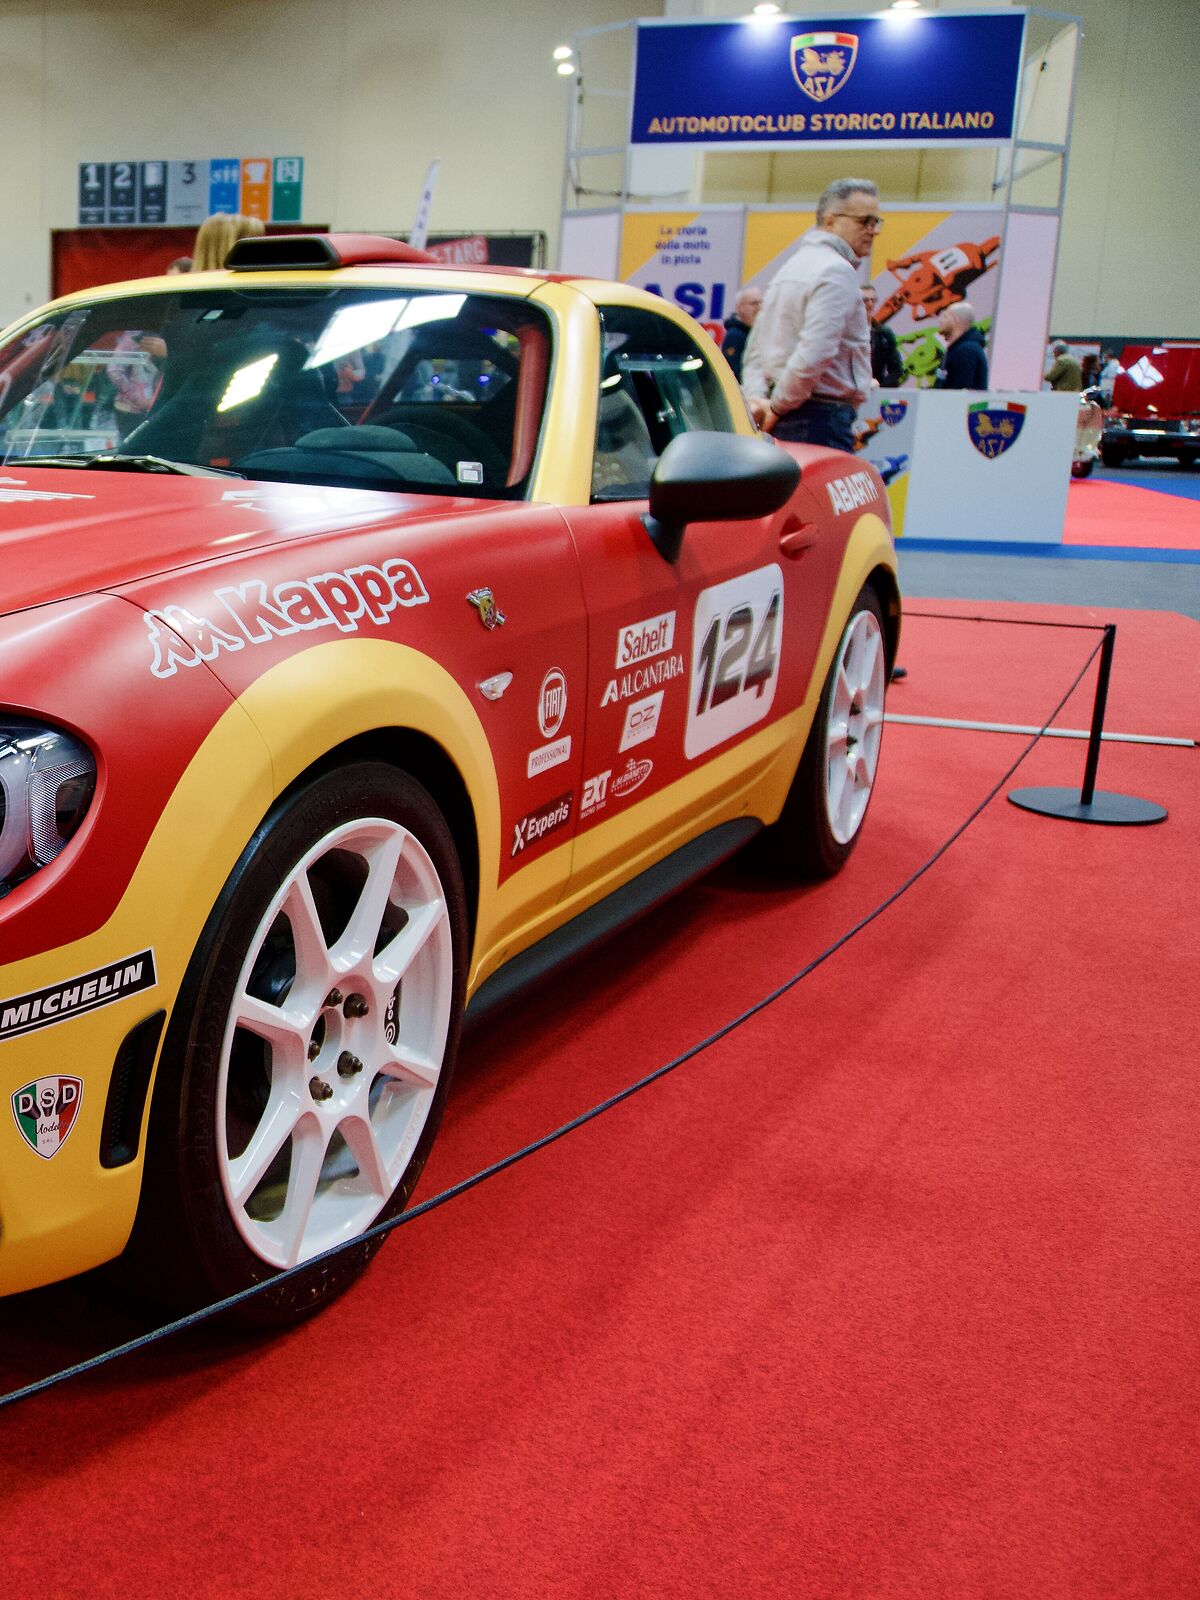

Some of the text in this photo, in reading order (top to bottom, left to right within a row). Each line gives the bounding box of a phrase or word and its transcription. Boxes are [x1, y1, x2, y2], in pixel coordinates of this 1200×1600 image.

[648, 111, 995, 134] AUTOMOTOCLUB STORICO ITALIANO
[84, 163, 100, 189] 1
[114, 163, 132, 188] 2
[182, 161, 196, 185] 3
[660, 225, 672, 235] La
[683, 239, 711, 250] moto
[674, 254, 702, 266] pista
[825, 471, 879, 516] ABARTH
[214, 558, 430, 644] Kappa
[622, 617, 669, 663] Sabelt
[696, 588, 781, 717] 124
[619, 655, 684, 700] ALCANTARA
[545, 686, 562, 720] FIAT
[531, 745, 567, 769] PROFESSIONAL
[526, 802, 570, 842] Experis
[0, 961, 144, 1029] MICHELIN
[19, 1084, 77, 1114] DSD
